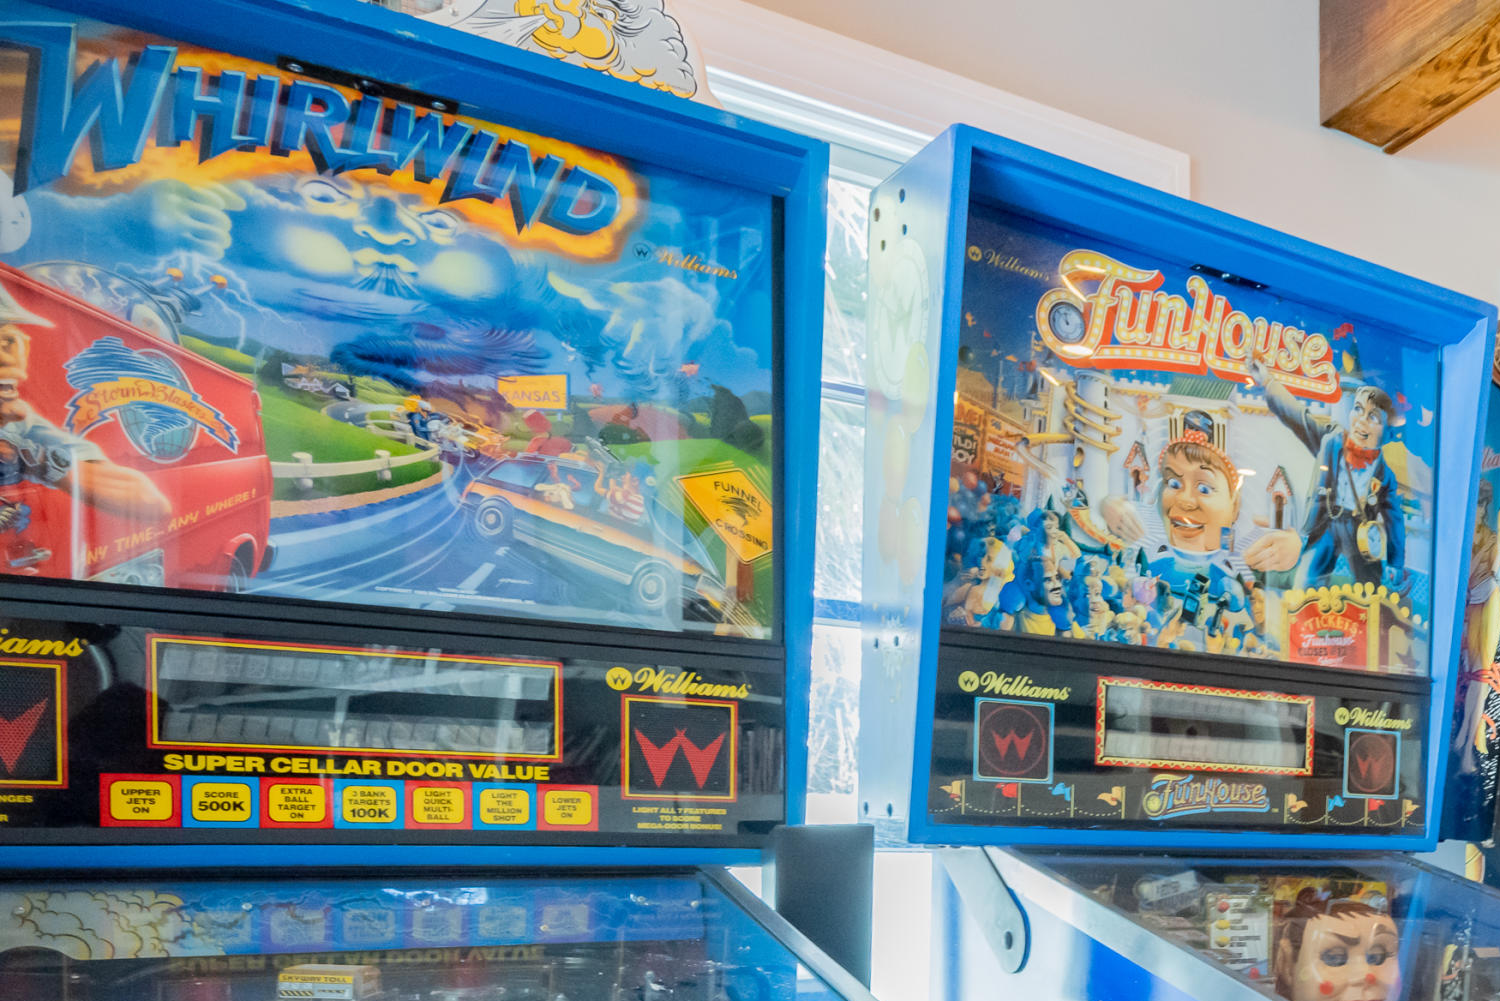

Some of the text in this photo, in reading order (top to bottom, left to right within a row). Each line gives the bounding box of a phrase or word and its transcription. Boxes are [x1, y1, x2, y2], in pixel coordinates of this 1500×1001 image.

[0, 22, 622, 235] WHIRLWIND
[984, 248, 1050, 282] Williams
[503, 390, 561, 403] KANSAS
[713, 481, 764, 514] FUNNEL
[168, 511, 200, 533] ANY
[715, 518, 770, 552] CROSSING
[1303, 614, 1360, 636] TICKETS
[634, 667, 751, 699] Williams
[980, 671, 1072, 701] Williams
[1350, 707, 1413, 730] Williams
[163, 753, 550, 781] SUPER CELLAR DOOR VALUE
[121, 788, 161, 797] UPPER
[204, 791, 239, 799] SCORE
[365, 790, 387, 798] BANK
[424, 790, 452, 798] LIGHT
[491, 792, 518, 800] LIGHT
[126, 797, 157, 806] JETS
[348, 798, 391, 806] TARGETS
[424, 798, 453, 806] QUICK
[552, 797, 582, 805] LOWER
[132, 806, 151, 815] ON
[198, 800, 246, 812] 500K
[556, 804, 577, 812] JETS
[350, 807, 390, 819] 100K
[487, 807, 522, 815] MILLION
[560, 811, 574, 819] ON
[426, 813, 450, 821] BALL
[493, 814, 517, 822] SHOT
[323, 976, 348, 984] TOLL
